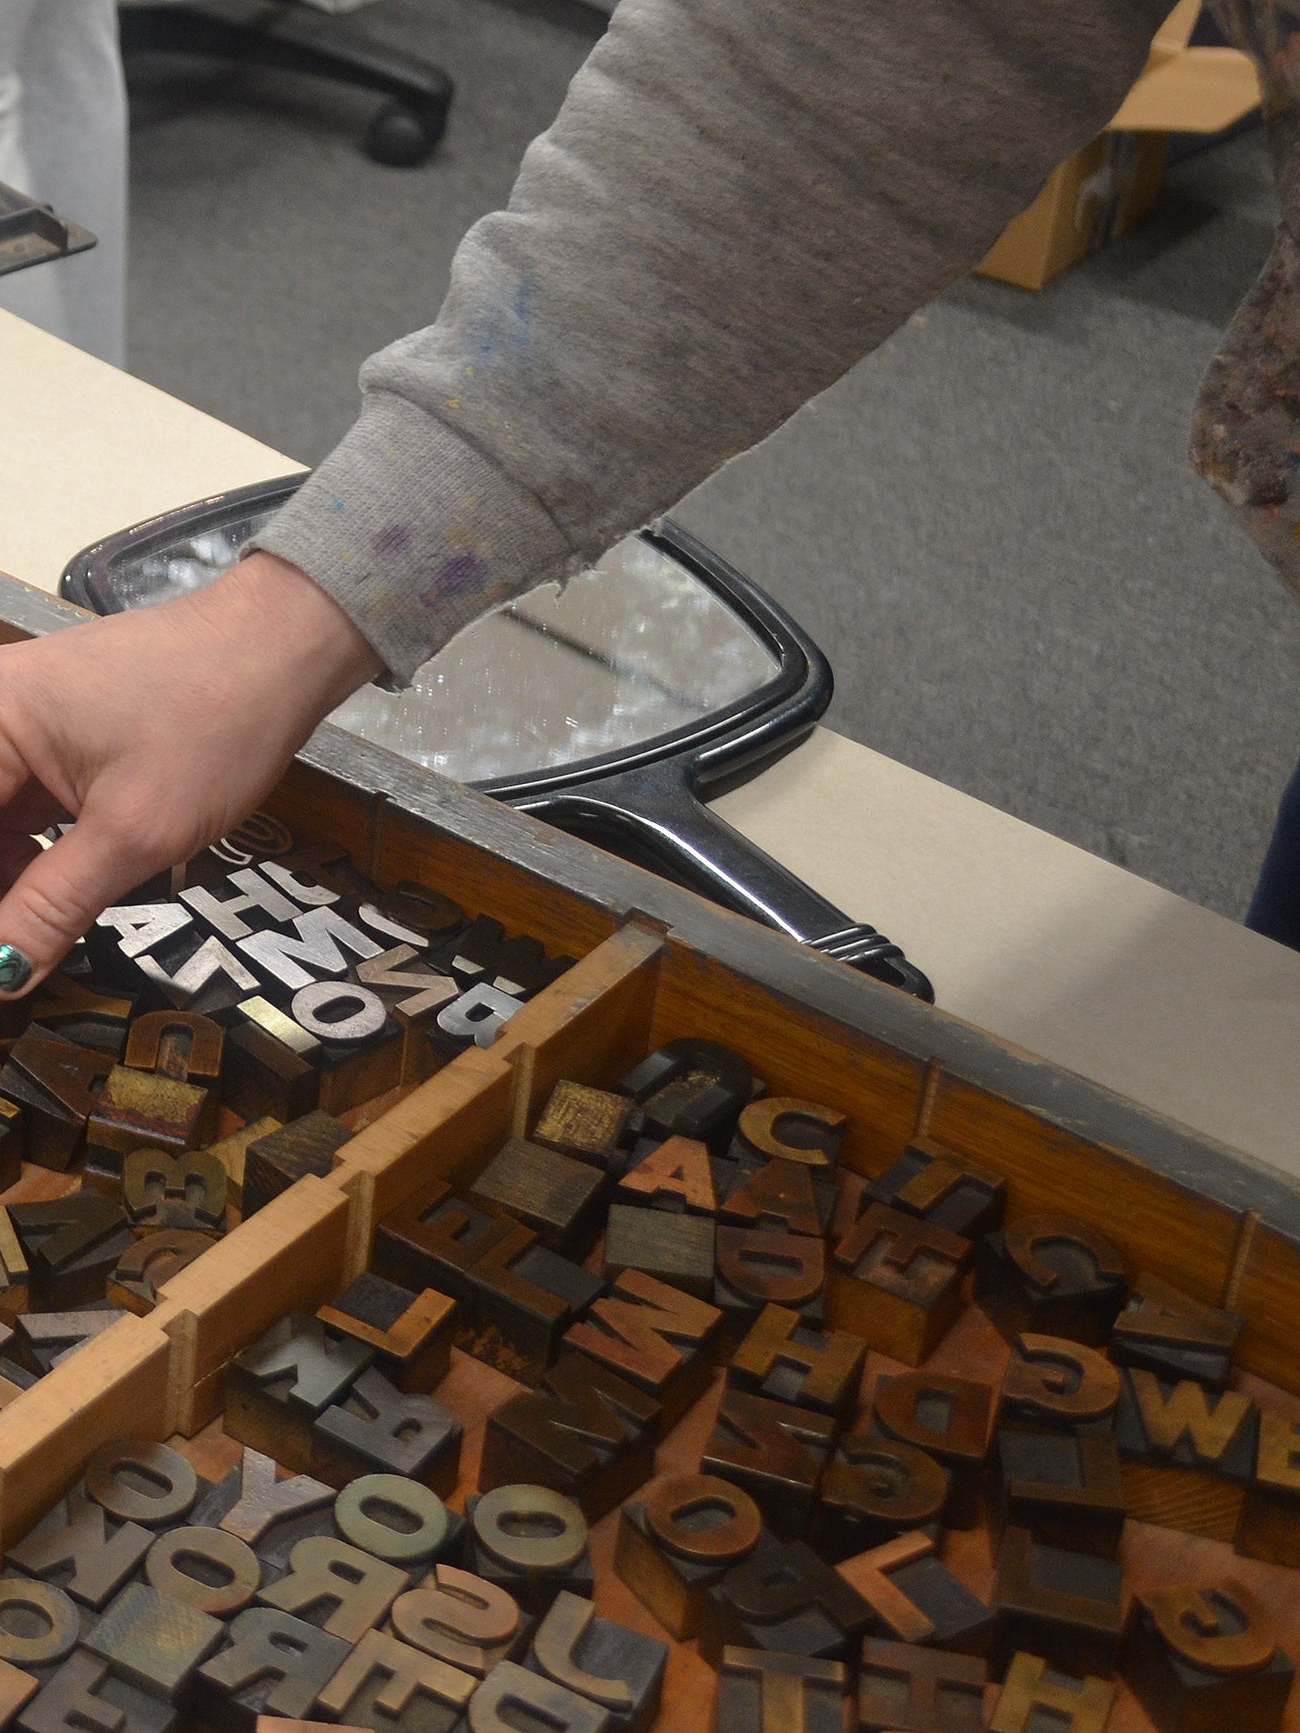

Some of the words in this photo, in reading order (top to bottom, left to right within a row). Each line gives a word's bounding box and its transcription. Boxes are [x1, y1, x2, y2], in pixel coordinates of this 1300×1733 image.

[178, 867, 304, 941] H
[236, 905, 385, 991] M
[291, 980, 388, 1041] O
[618, 1134, 718, 1211] A
[739, 1096, 847, 1166] C
[86, 1439, 198, 1521] O
[219, 1445, 339, 1545] Y
[334, 1473, 449, 1562] O
[474, 1484, 588, 1568] O
[145, 1526, 261, 1615] O
